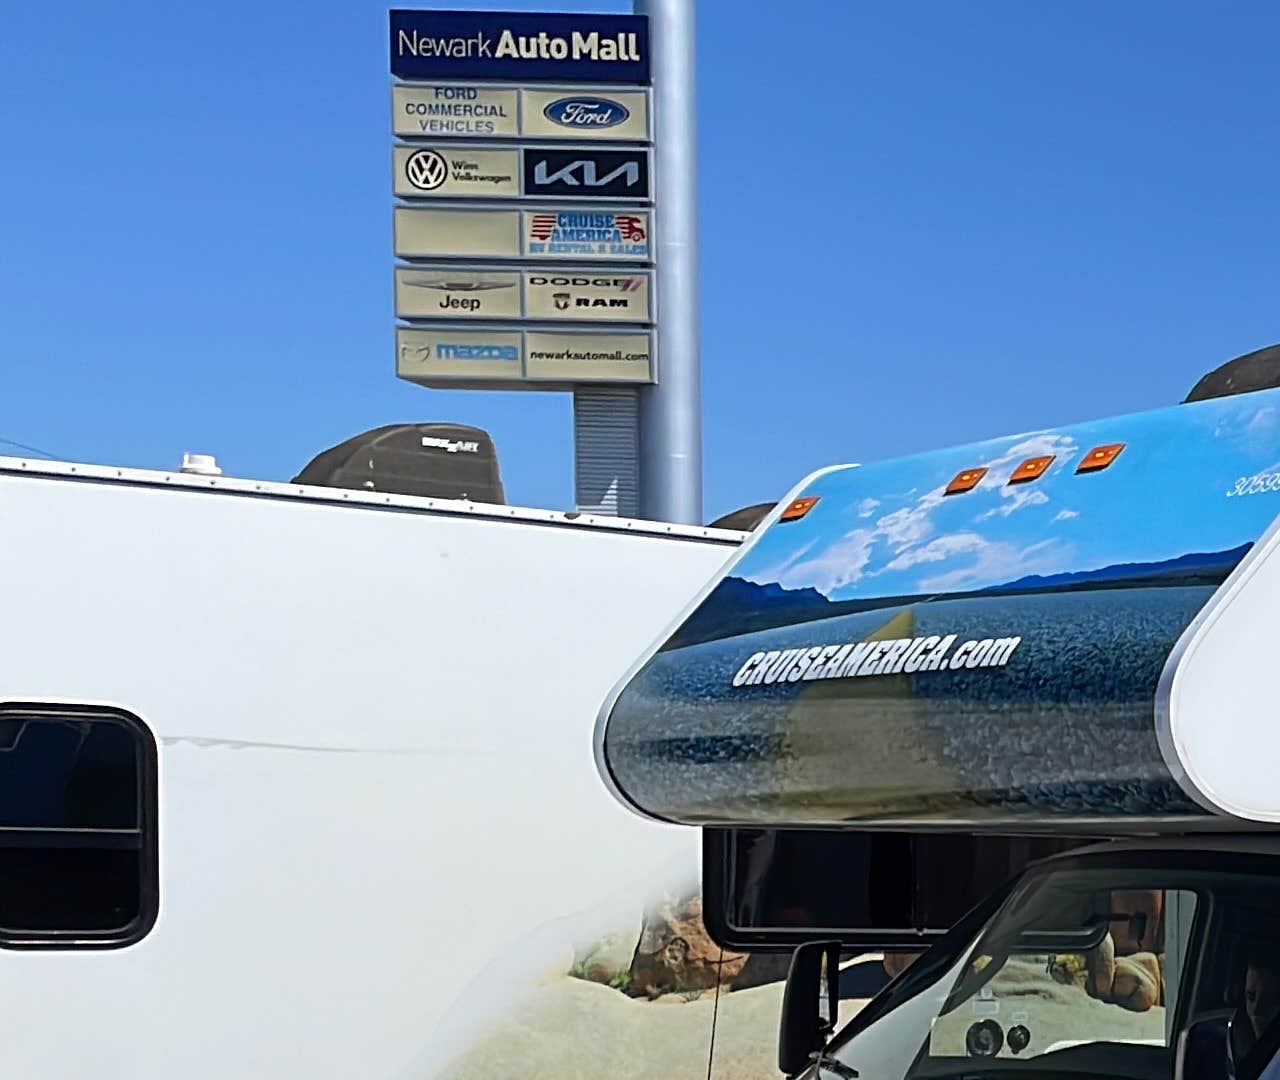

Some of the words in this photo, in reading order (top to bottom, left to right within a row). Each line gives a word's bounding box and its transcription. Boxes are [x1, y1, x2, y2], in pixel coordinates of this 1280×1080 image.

[398, 30, 491, 58] Newark
[434, 87, 477, 99] FORD
[405, 103, 507, 118] COMMERCIAL
[559, 103, 613, 125] Ford
[419, 119, 494, 133] VEHICLES
[557, 213, 616, 228] CRUISE
[551, 229, 622, 243] AMERICA
[439, 295, 481, 312] Jeep
[575, 298, 629, 308] RAM
[530, 351, 648, 361] newarkautomall.com
[732, 634, 1021, 687] CRUISEAMERICA.com
